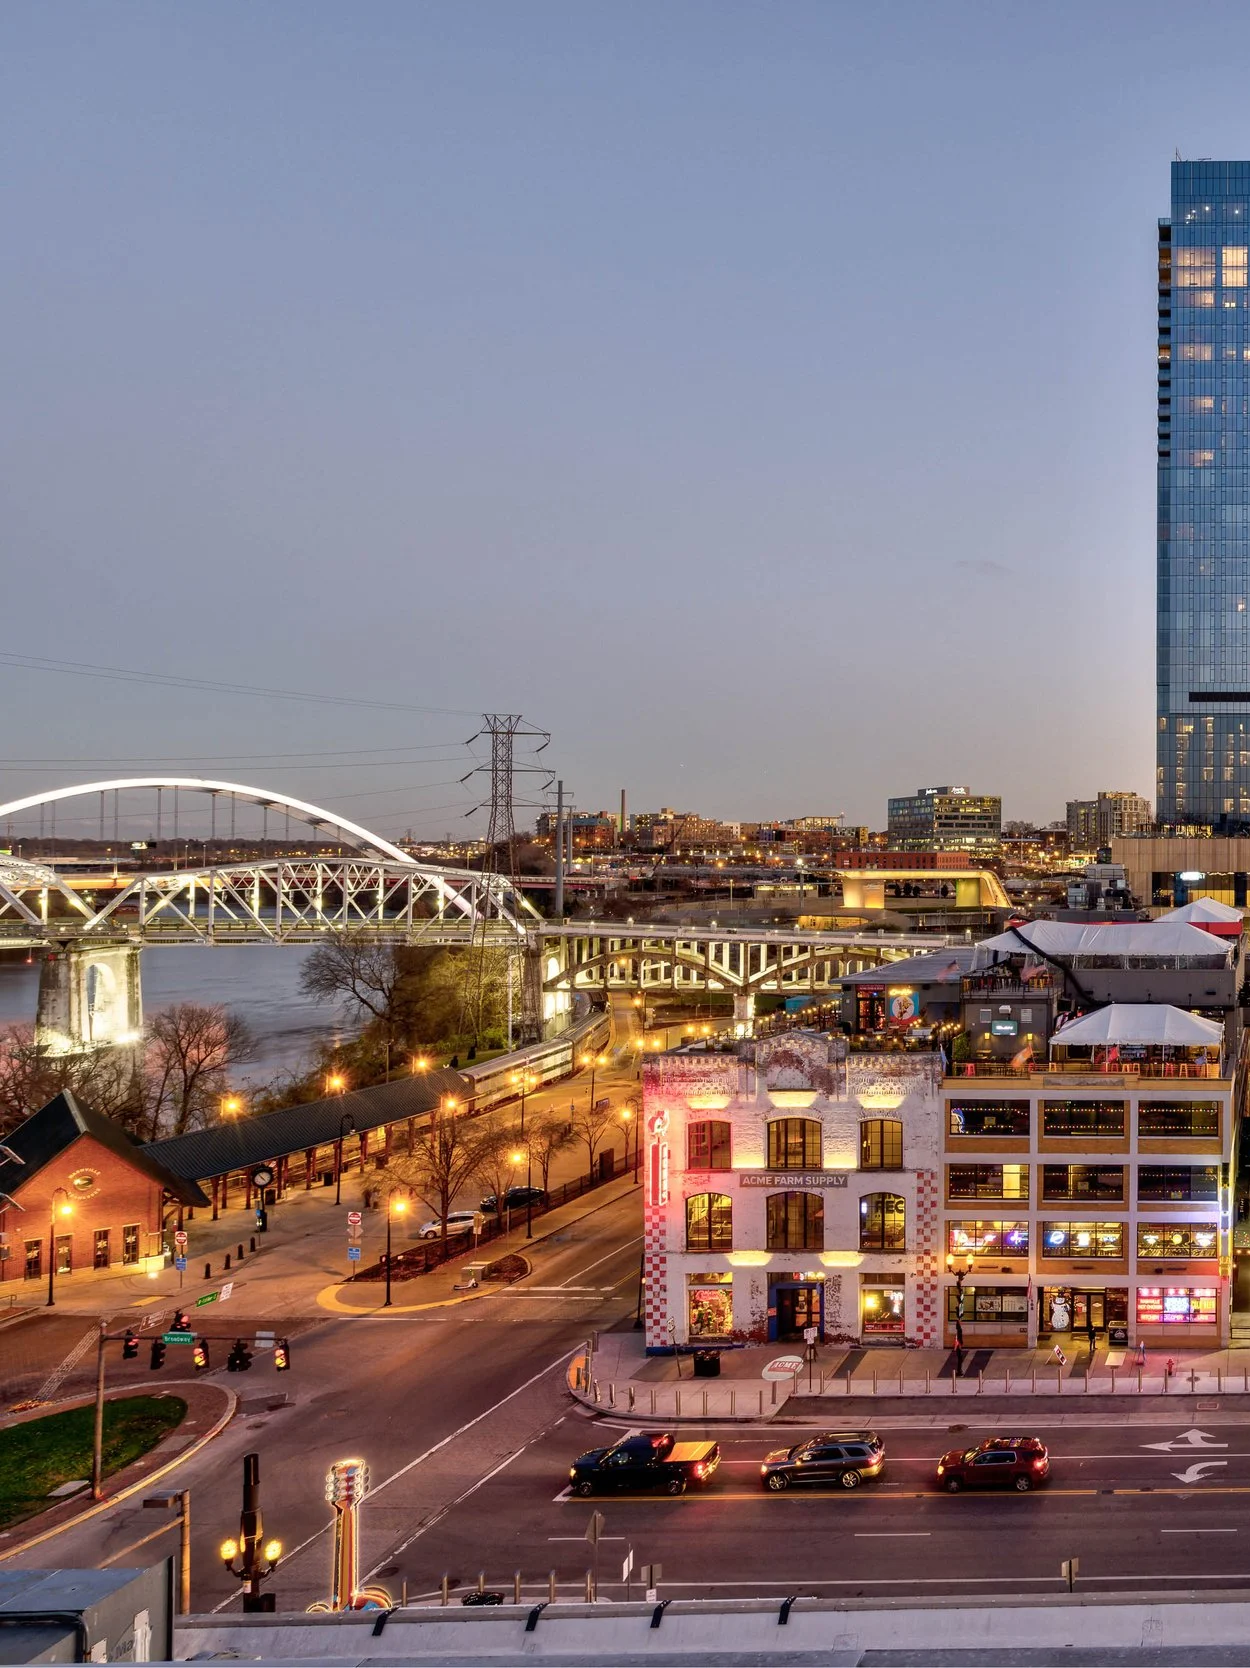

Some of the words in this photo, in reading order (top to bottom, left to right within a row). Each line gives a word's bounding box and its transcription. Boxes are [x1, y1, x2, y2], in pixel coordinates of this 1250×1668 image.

[742, 1176, 773, 1185] ACME
[774, 1176, 804, 1185] FARM
[805, 1176, 845, 1185] SUPPLY
[164, 1335, 191, 1343] Broadway
[773, 1361, 800, 1370] ACME
